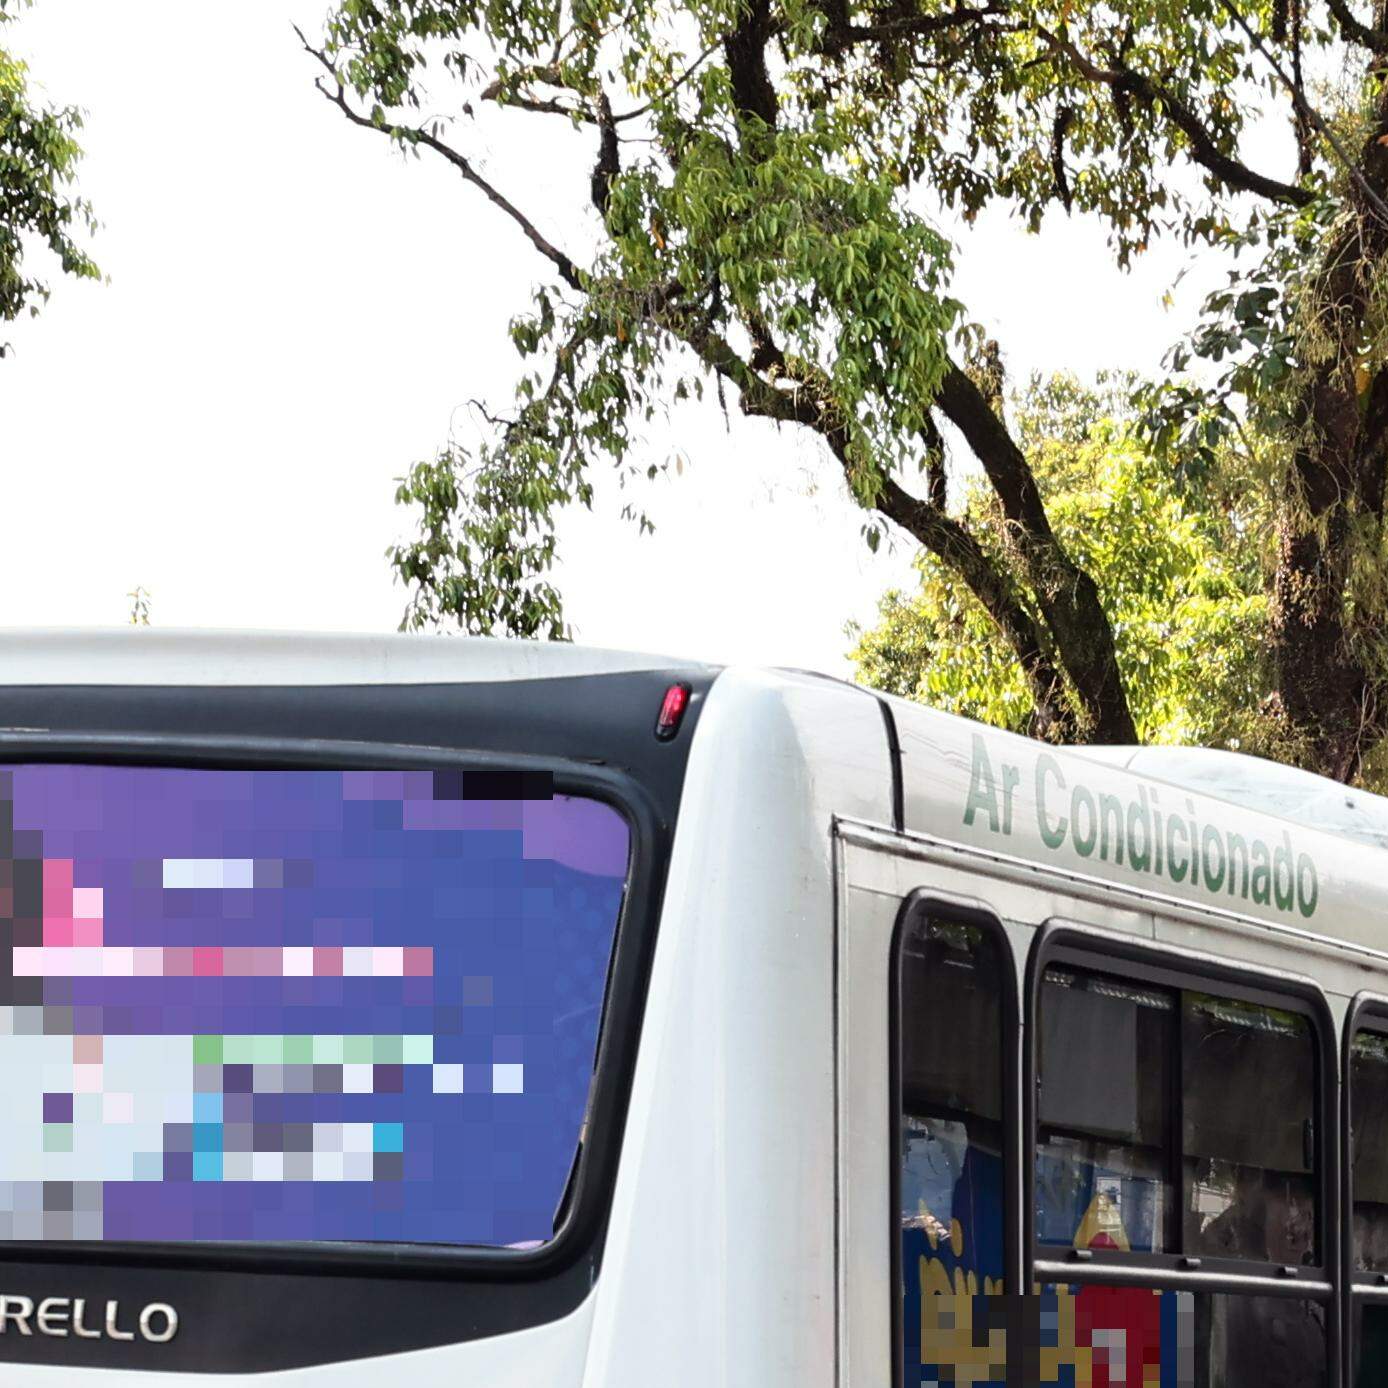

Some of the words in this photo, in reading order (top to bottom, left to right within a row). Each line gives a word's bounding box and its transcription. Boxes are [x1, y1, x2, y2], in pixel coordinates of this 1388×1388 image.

[963, 733, 1020, 836] Ar
[1035, 753, 1320, 918] Condicionado
[0, 1294, 178, 1343] RELLO
